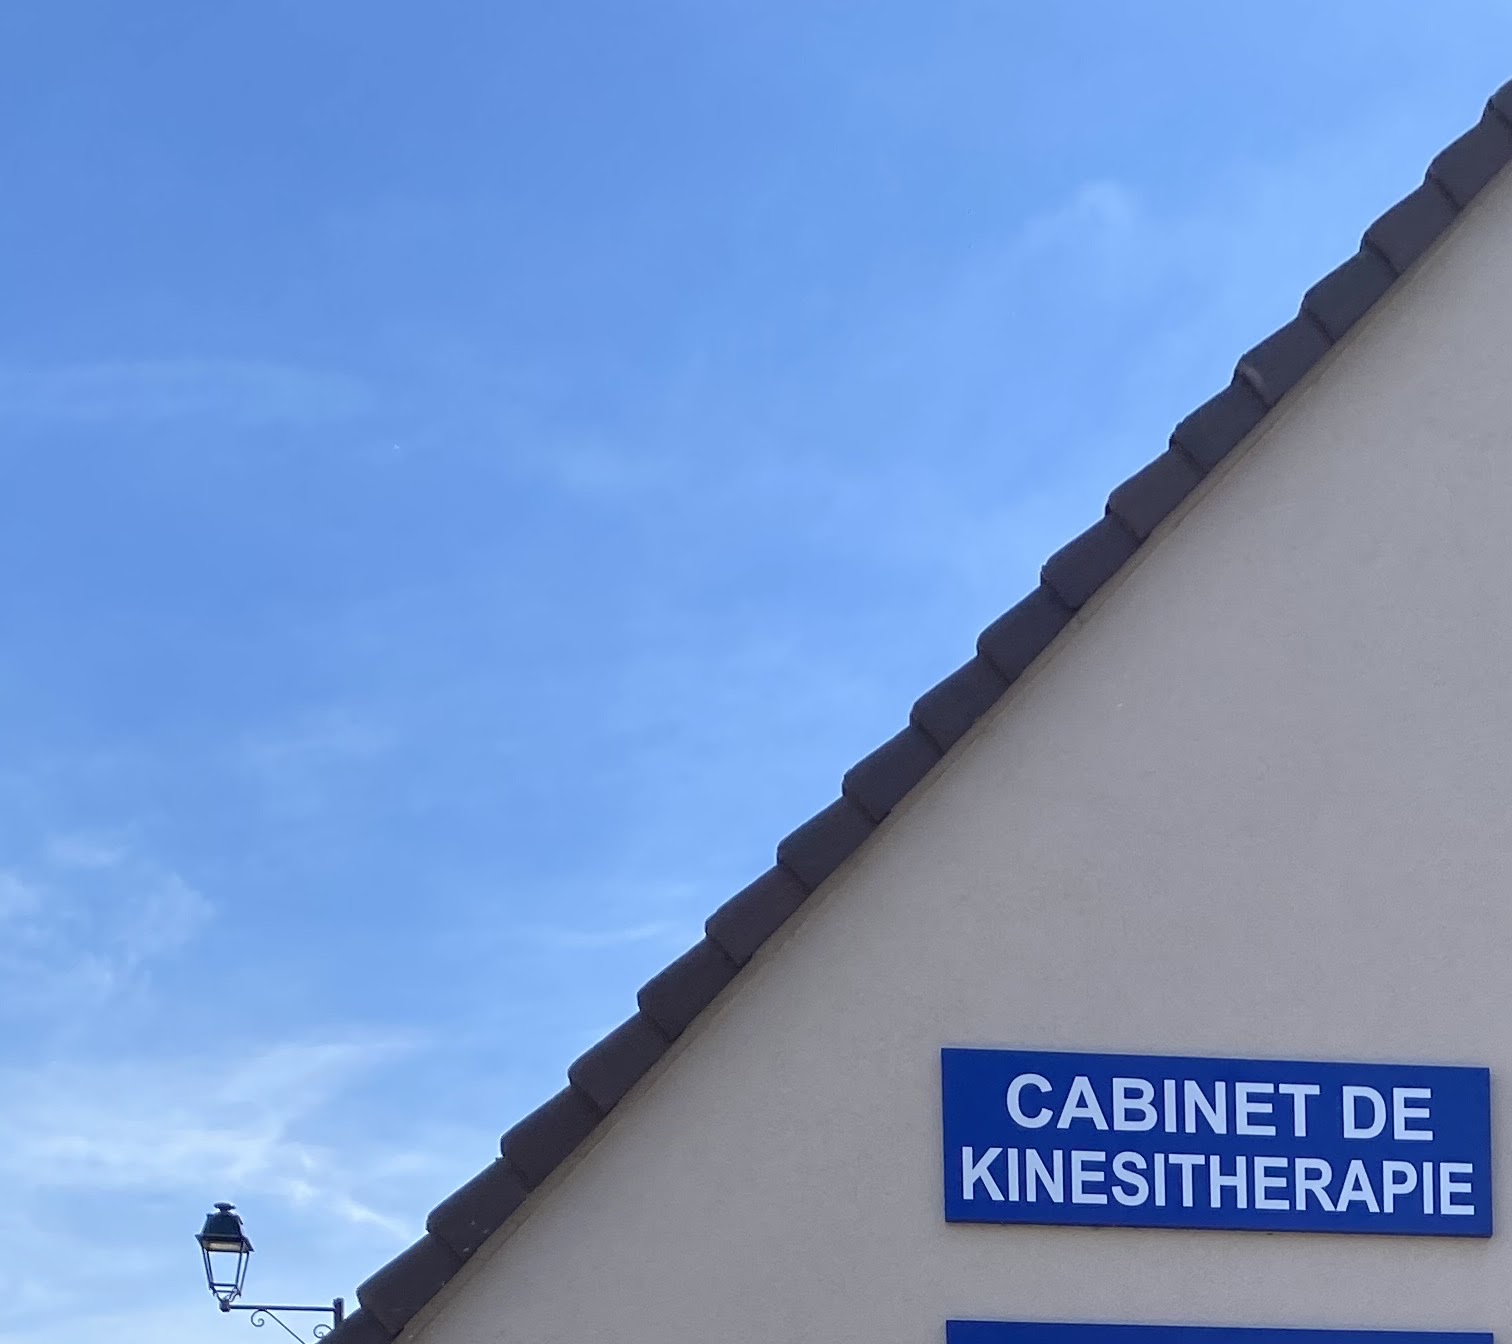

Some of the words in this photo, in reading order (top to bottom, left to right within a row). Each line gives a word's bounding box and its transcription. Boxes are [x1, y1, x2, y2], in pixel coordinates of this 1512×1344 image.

[1007, 1074, 1320, 1137] CABINET
[1343, 1086, 1433, 1141] DE
[962, 1147, 1475, 1216] KINESITHERAPIE
